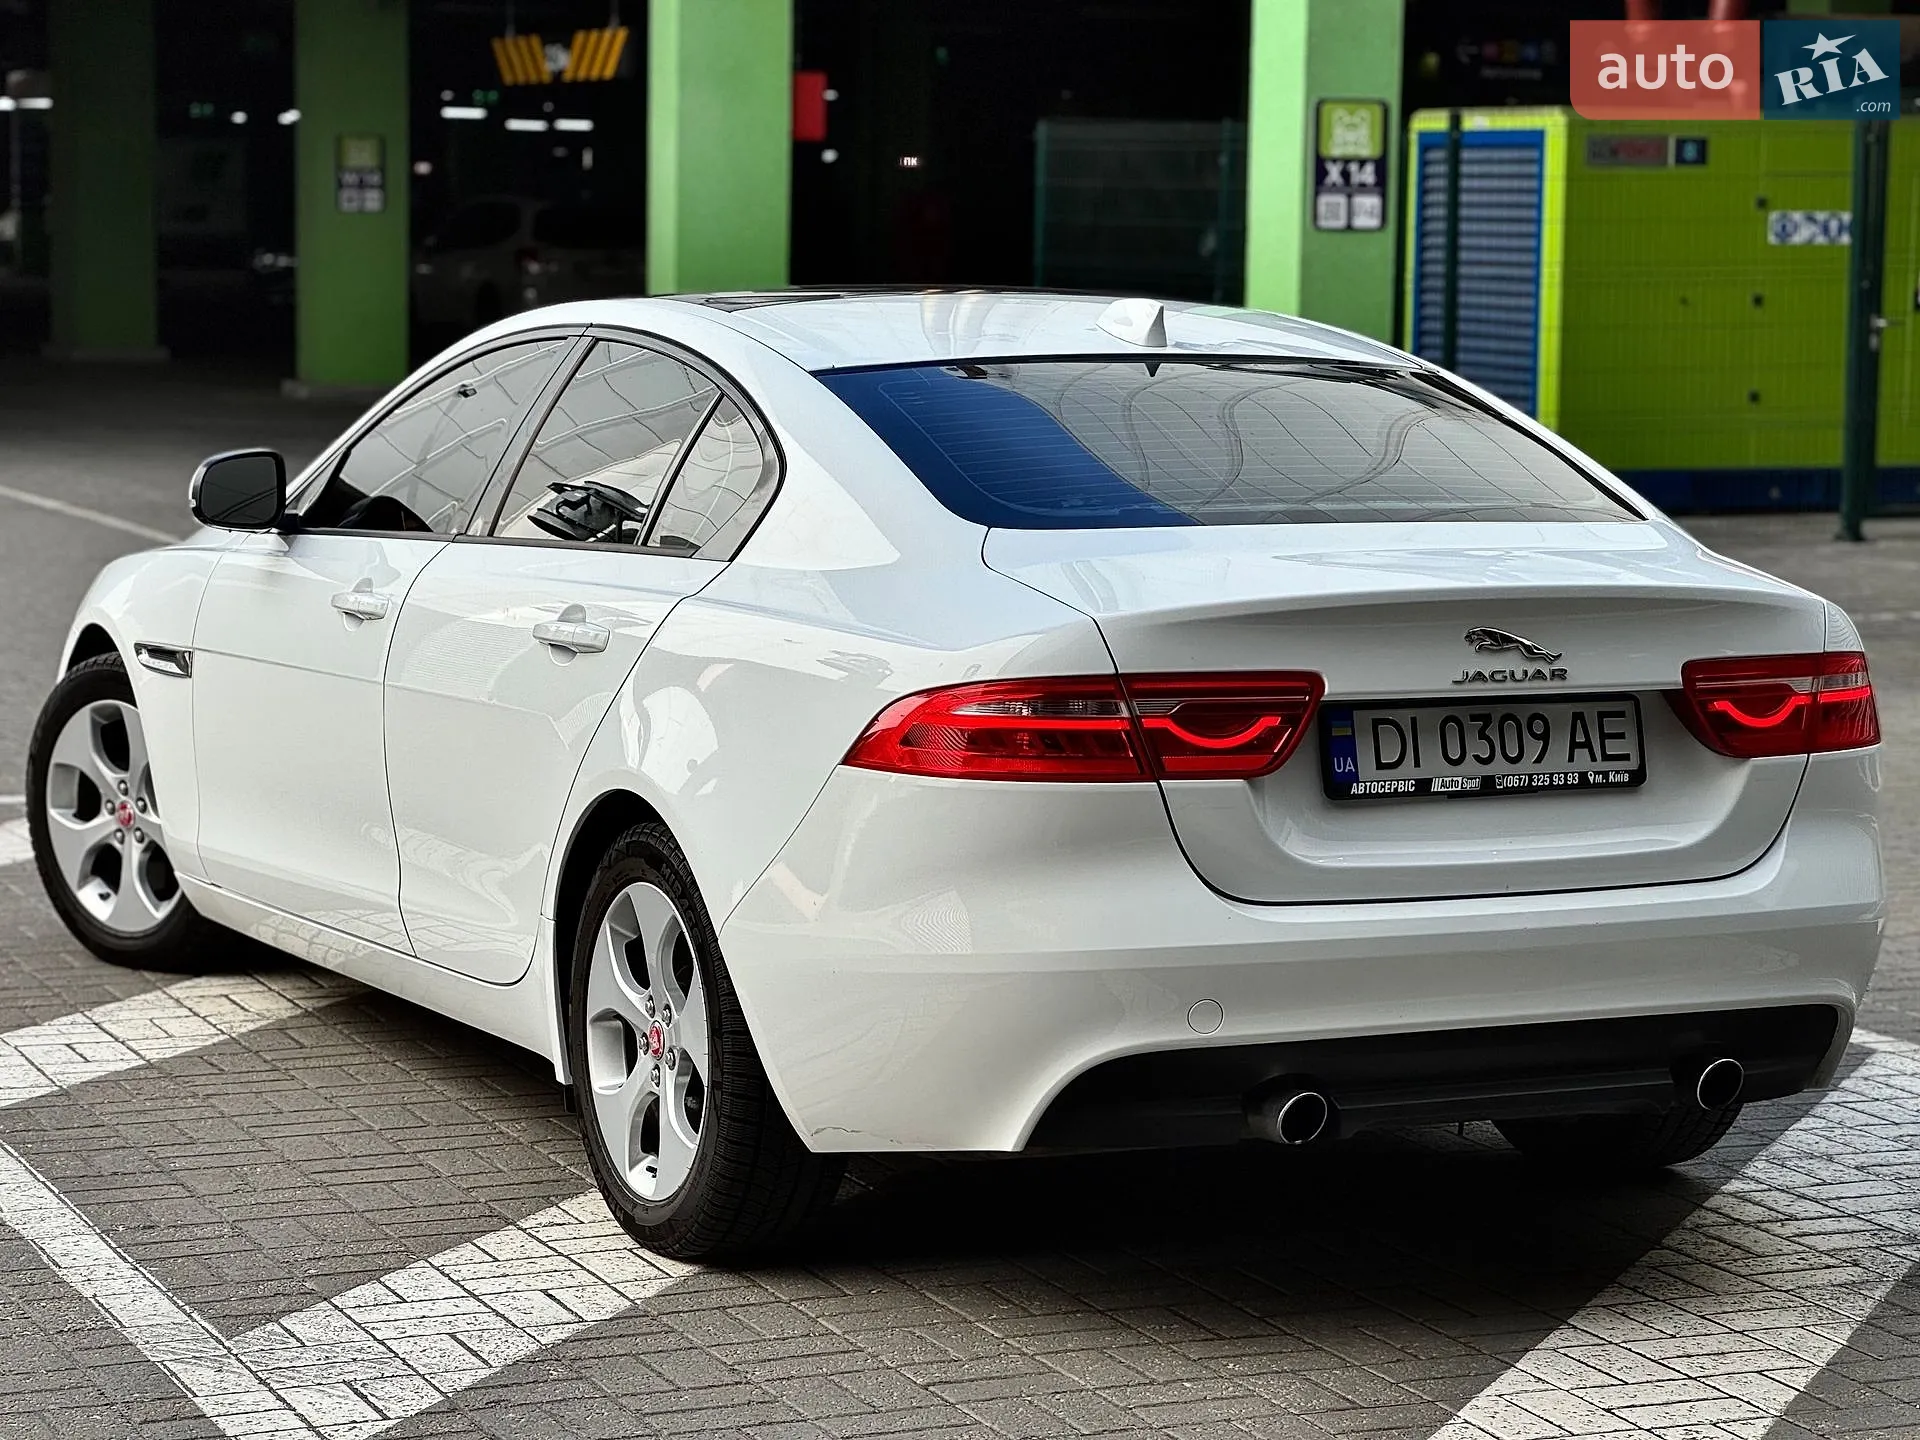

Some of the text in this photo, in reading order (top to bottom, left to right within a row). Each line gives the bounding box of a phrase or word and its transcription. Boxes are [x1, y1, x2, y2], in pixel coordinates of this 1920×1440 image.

[1451, 667, 1568, 684] JAGUAR
[1371, 710, 1631, 771] DI 0309 AE
[1333, 756, 1356, 773] UA
[1503, 772, 1579, 788] (067) 325 93 93
[1608, 770, 1630, 783] Київ
[1350, 780, 1416, 795] АВТОСЕРВІС
